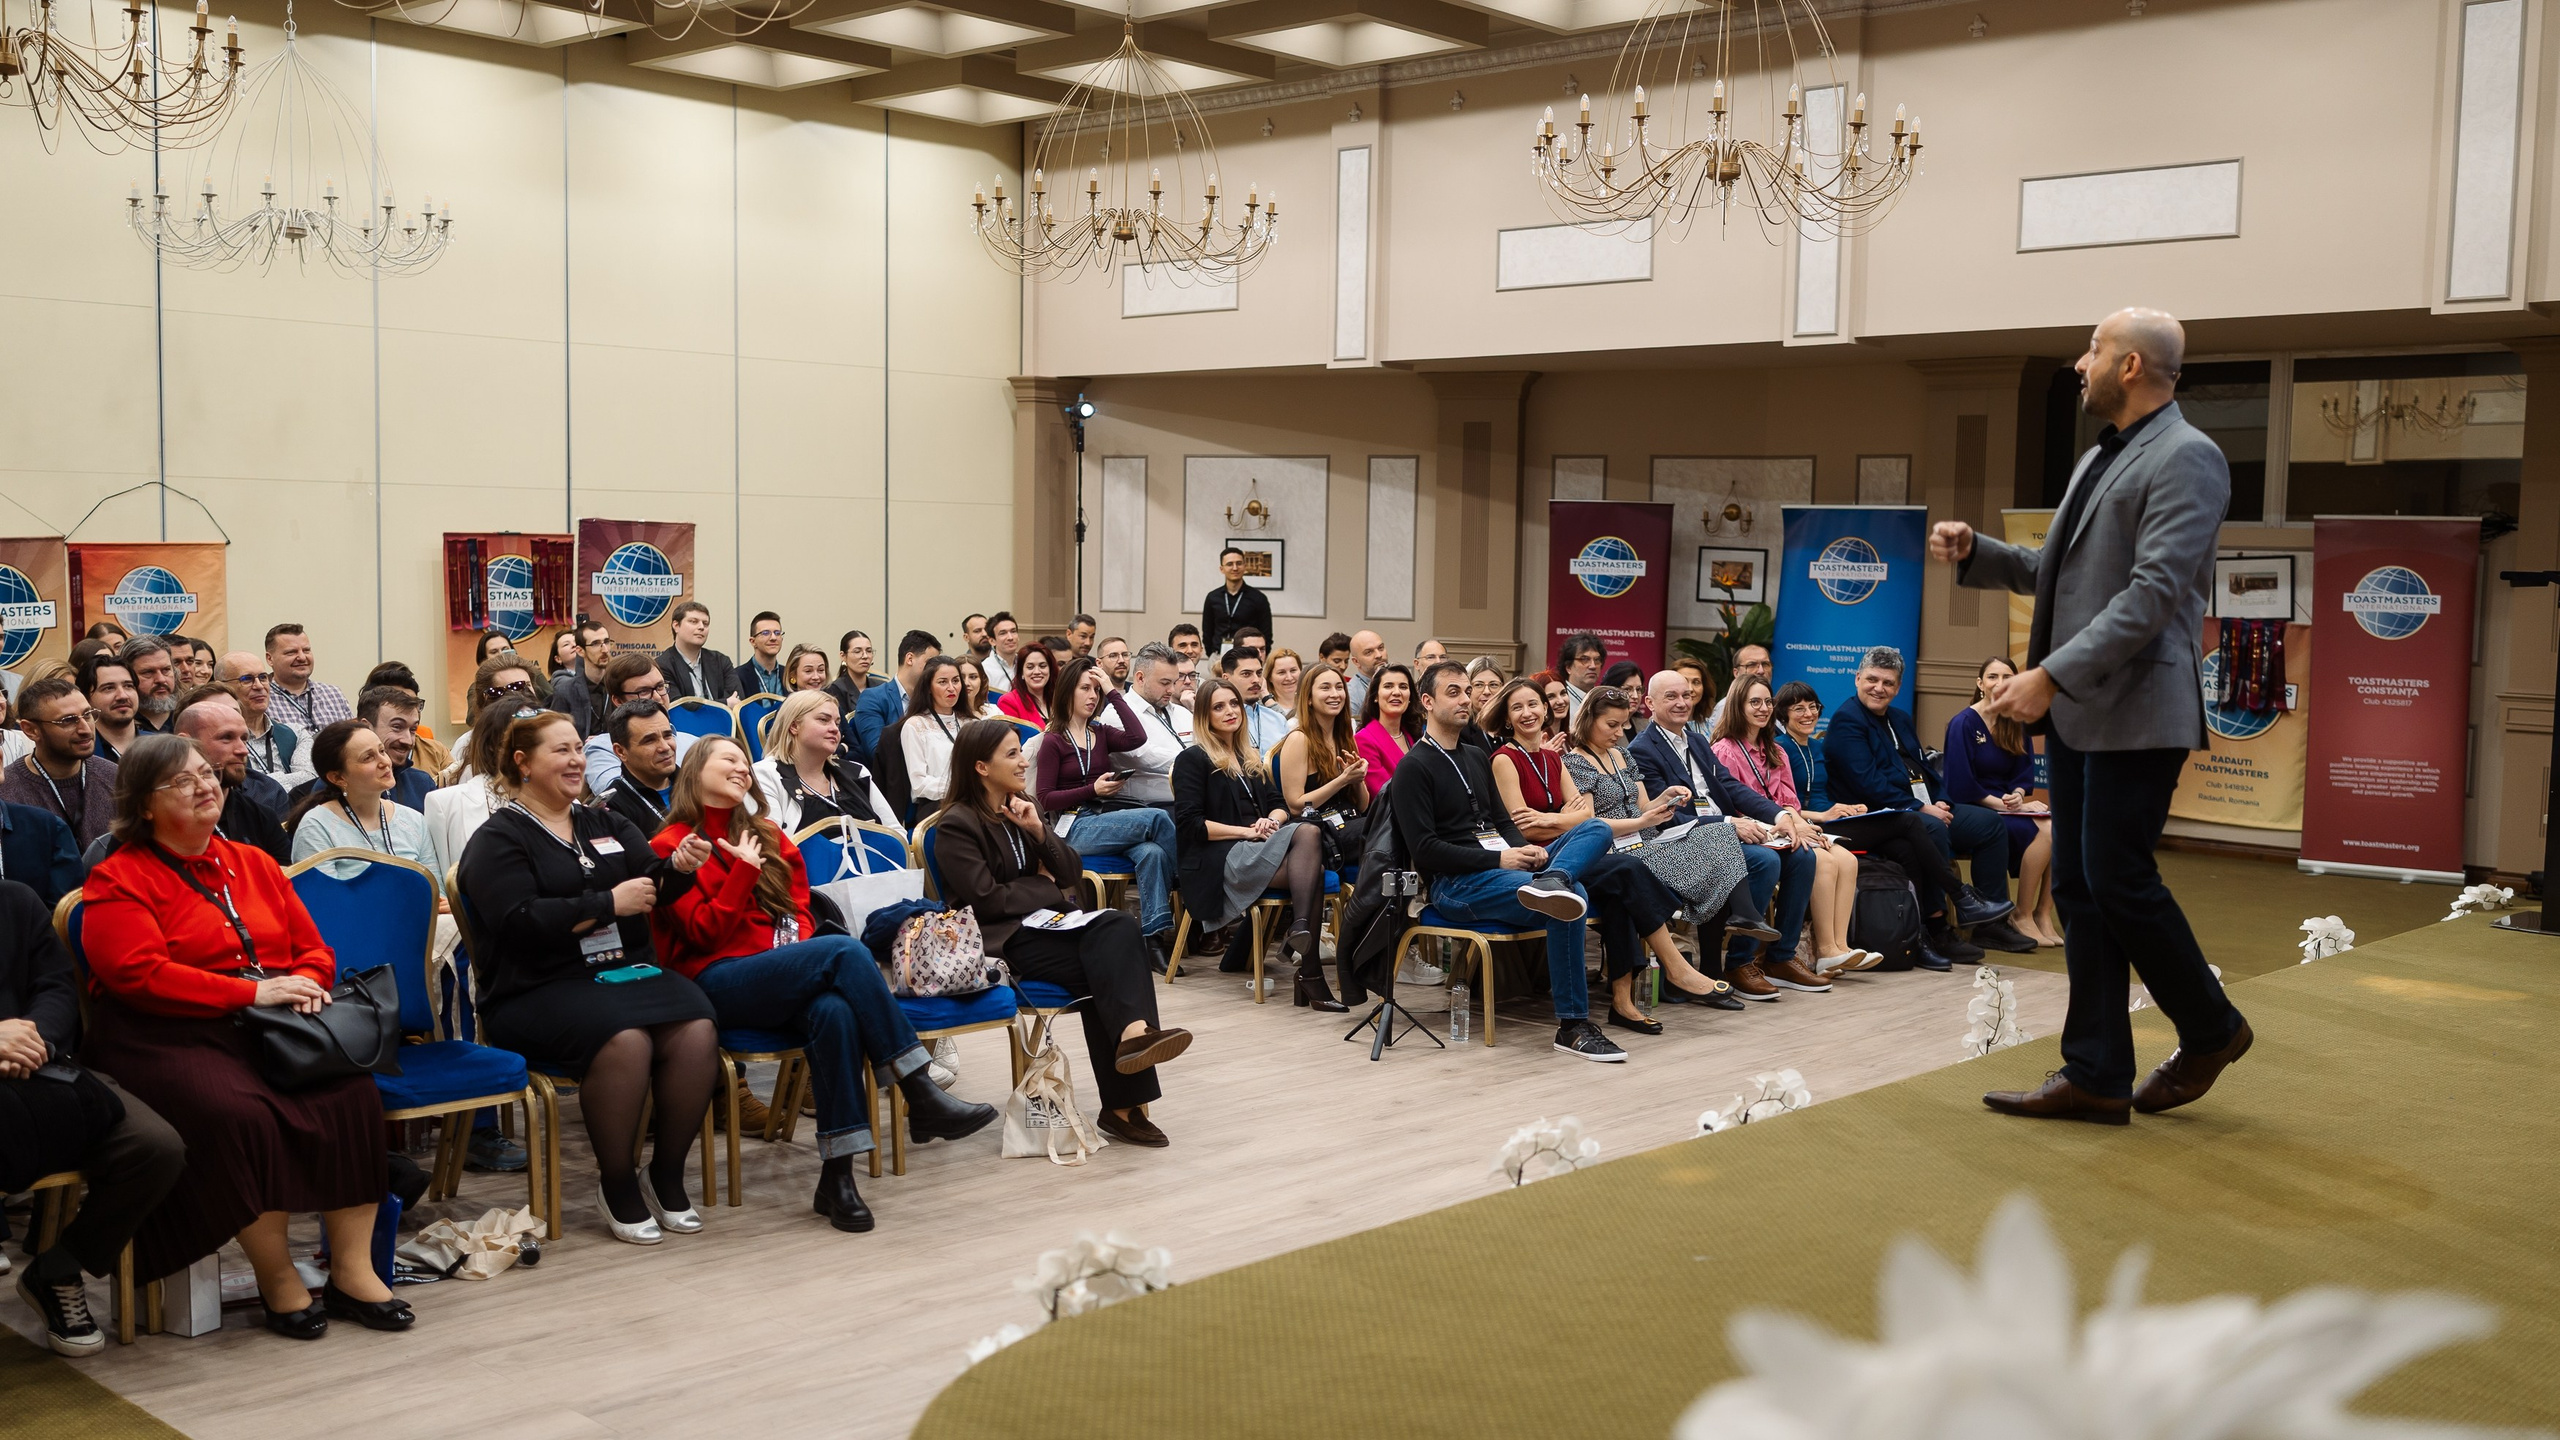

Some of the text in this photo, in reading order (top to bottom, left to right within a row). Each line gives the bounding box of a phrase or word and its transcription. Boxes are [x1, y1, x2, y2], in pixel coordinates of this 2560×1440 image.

[1572, 560, 1644, 569] TOASTMASTERS
[1812, 563, 1885, 573] TOASTMASTERS
[595, 575, 680, 587] TOASTMASTERS
[604, 586, 671, 594] INTERNATIONAL
[107, 595, 194, 605] TOASTMASTERS
[489, 591, 533, 600] STMAST
[2347, 595, 2438, 606] TOASTMASTERS
[0, 605, 51, 618] ASTERS
[116, 604, 185, 612] INTERNATIONAL
[2356, 604, 2427, 612] INTERNATIONAL
[1592, 629, 1655, 638] TOASTMASTERS
[1786, 643, 1821, 652] CHISINAU
[1806, 665, 1836, 675] Republic
[2348, 677, 2430, 688] TOASTMASTERS
[2210, 755, 2252, 766] RADAUTI
[2193, 763, 2269, 779] TOASTMASTERS
[2205, 780, 2222, 788] Club
[2228, 795, 2260, 807] Romania
[2342, 839, 2420, 852] www.toastmasters.org
